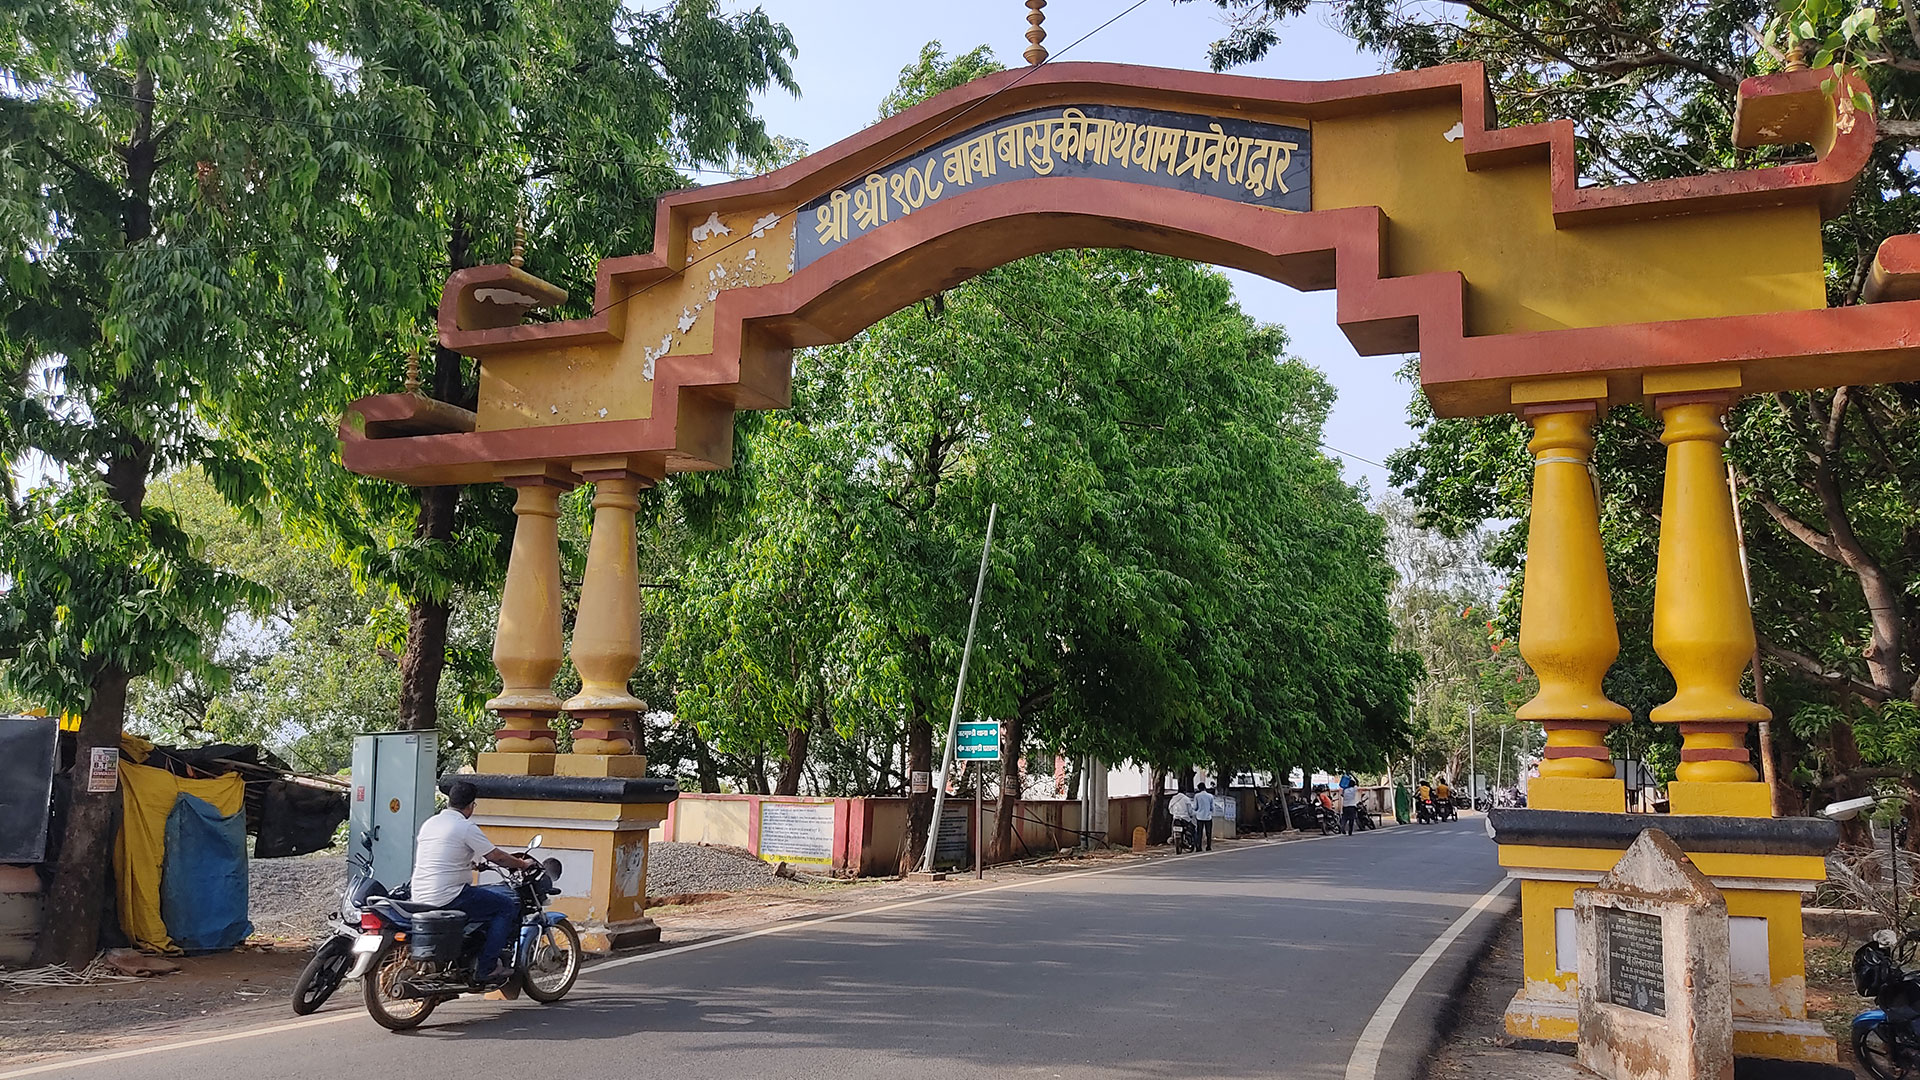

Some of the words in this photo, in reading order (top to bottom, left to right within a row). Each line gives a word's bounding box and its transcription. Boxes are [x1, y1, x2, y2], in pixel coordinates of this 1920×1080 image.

[814, 189, 851, 245] श्री
[852, 173, 888, 230] श्री
[889, 157, 944, 215] १०८
[941, 130, 997, 186] बाबा
